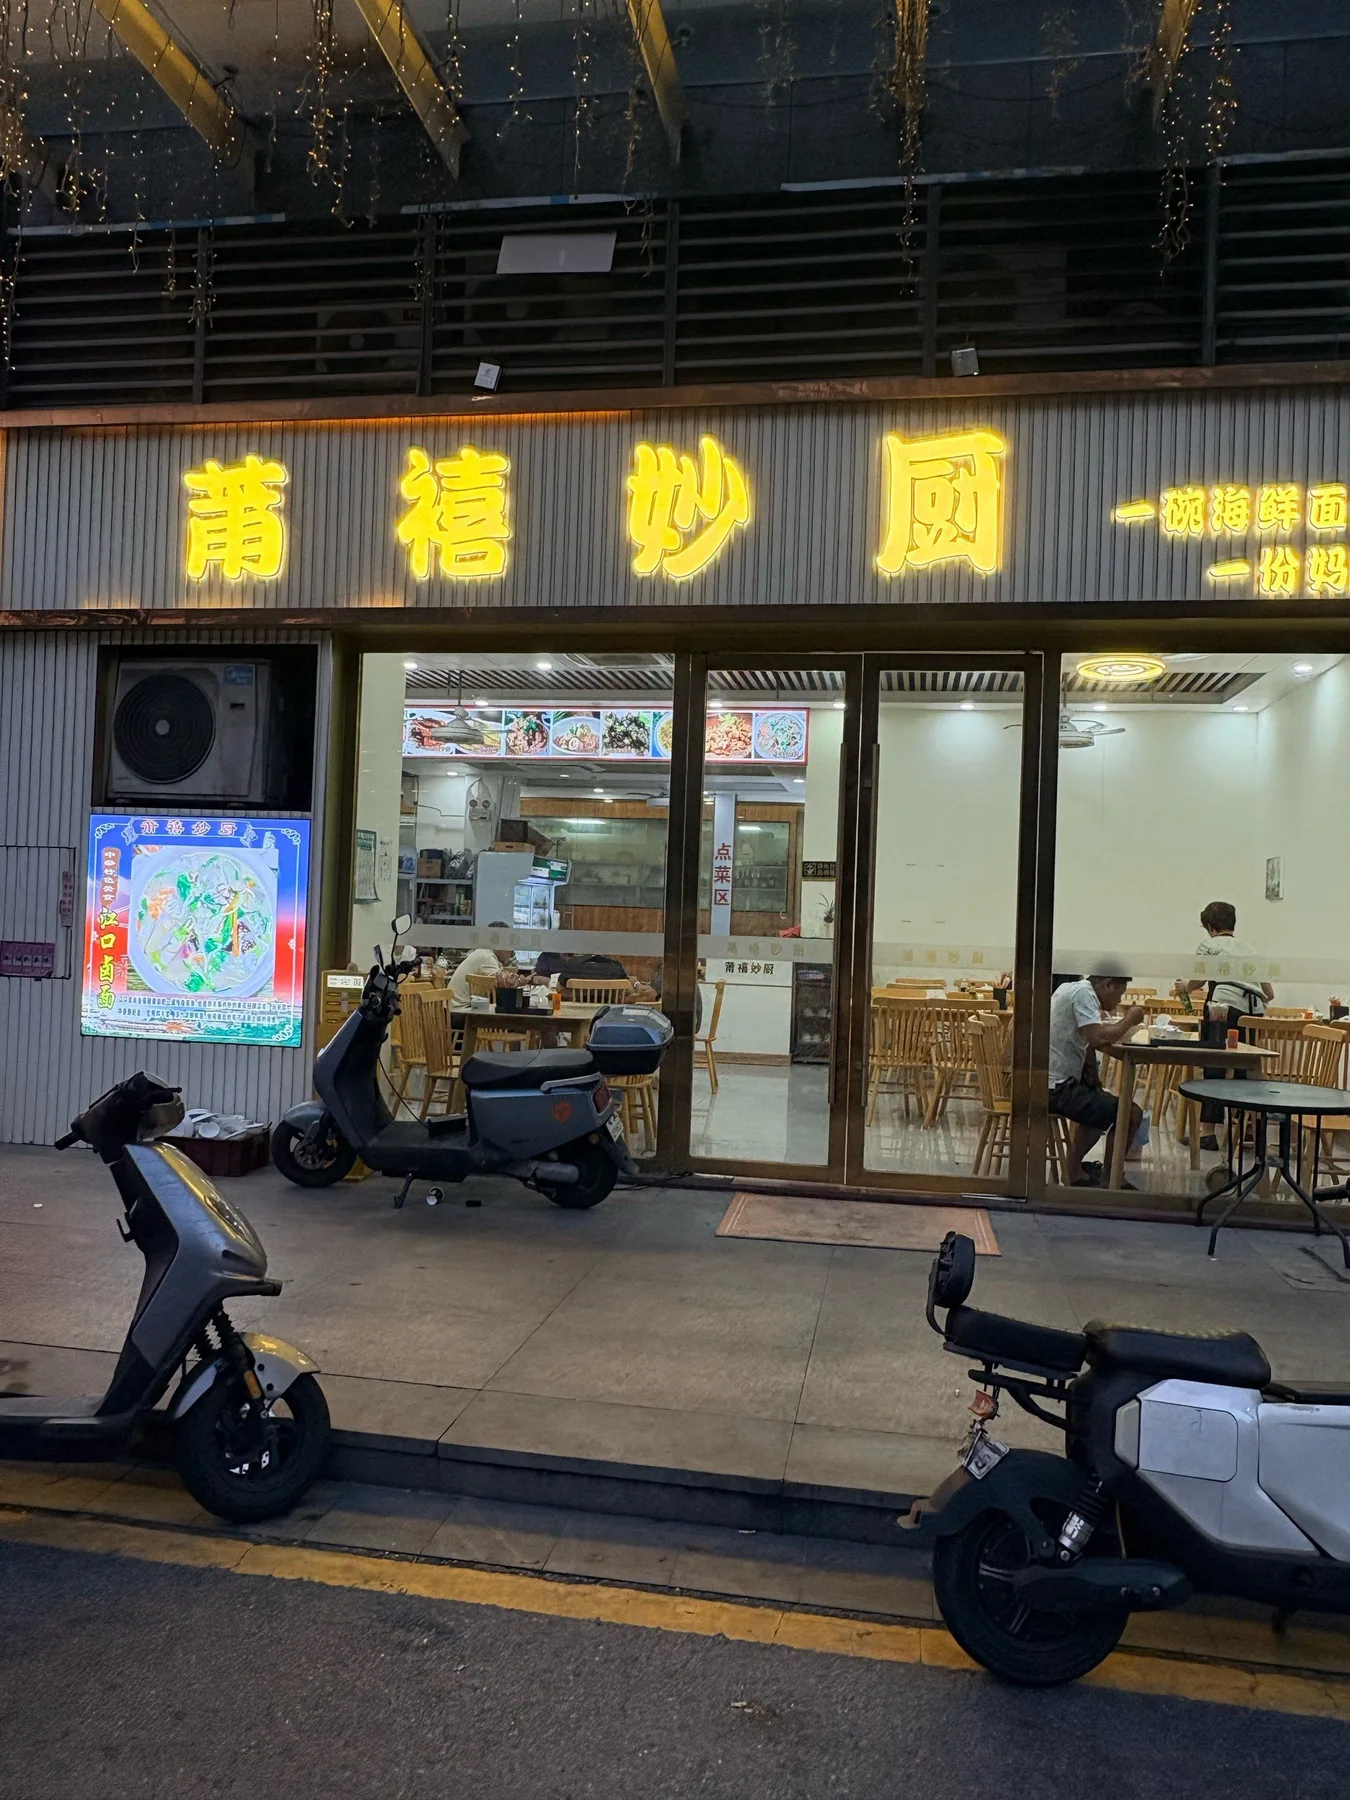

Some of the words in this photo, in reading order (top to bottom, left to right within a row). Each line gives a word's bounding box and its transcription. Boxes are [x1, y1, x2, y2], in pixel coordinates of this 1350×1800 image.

[184, 432, 1005, 579] 莆禧妙厨
[1115, 484, 1347, 534] 一碗海鲜面
[1208, 545, 1347, 592] 一份妈
[714, 843, 732, 905] 点菜区
[97, 906, 119, 1010] 江口卤面
